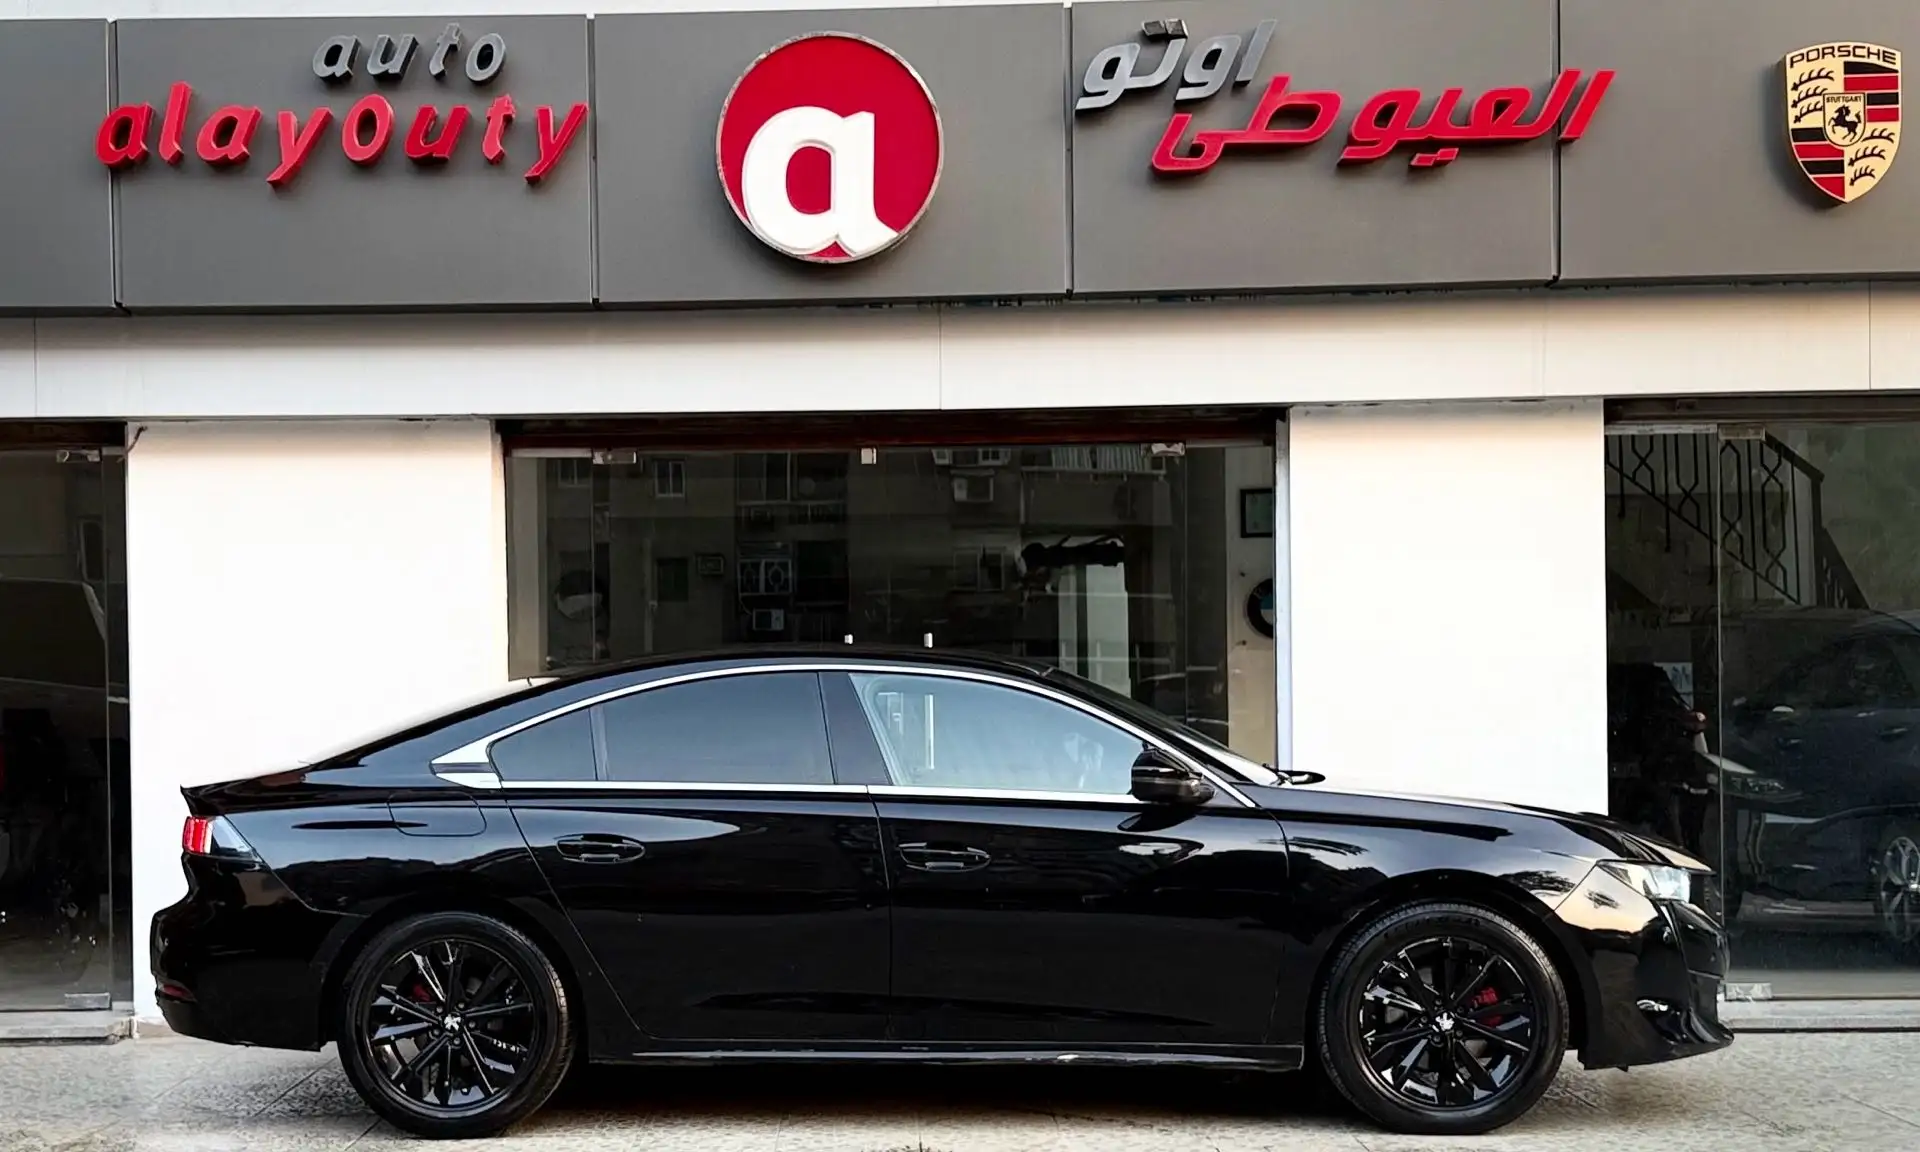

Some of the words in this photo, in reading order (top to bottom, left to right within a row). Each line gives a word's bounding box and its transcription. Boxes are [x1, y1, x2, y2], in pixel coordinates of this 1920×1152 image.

[313, 23, 506, 84] auto
[1790, 44, 1897, 69] PORSCHE
[1826, 95, 1862, 104] STUTTGART
[741, 105, 899, 257] a
